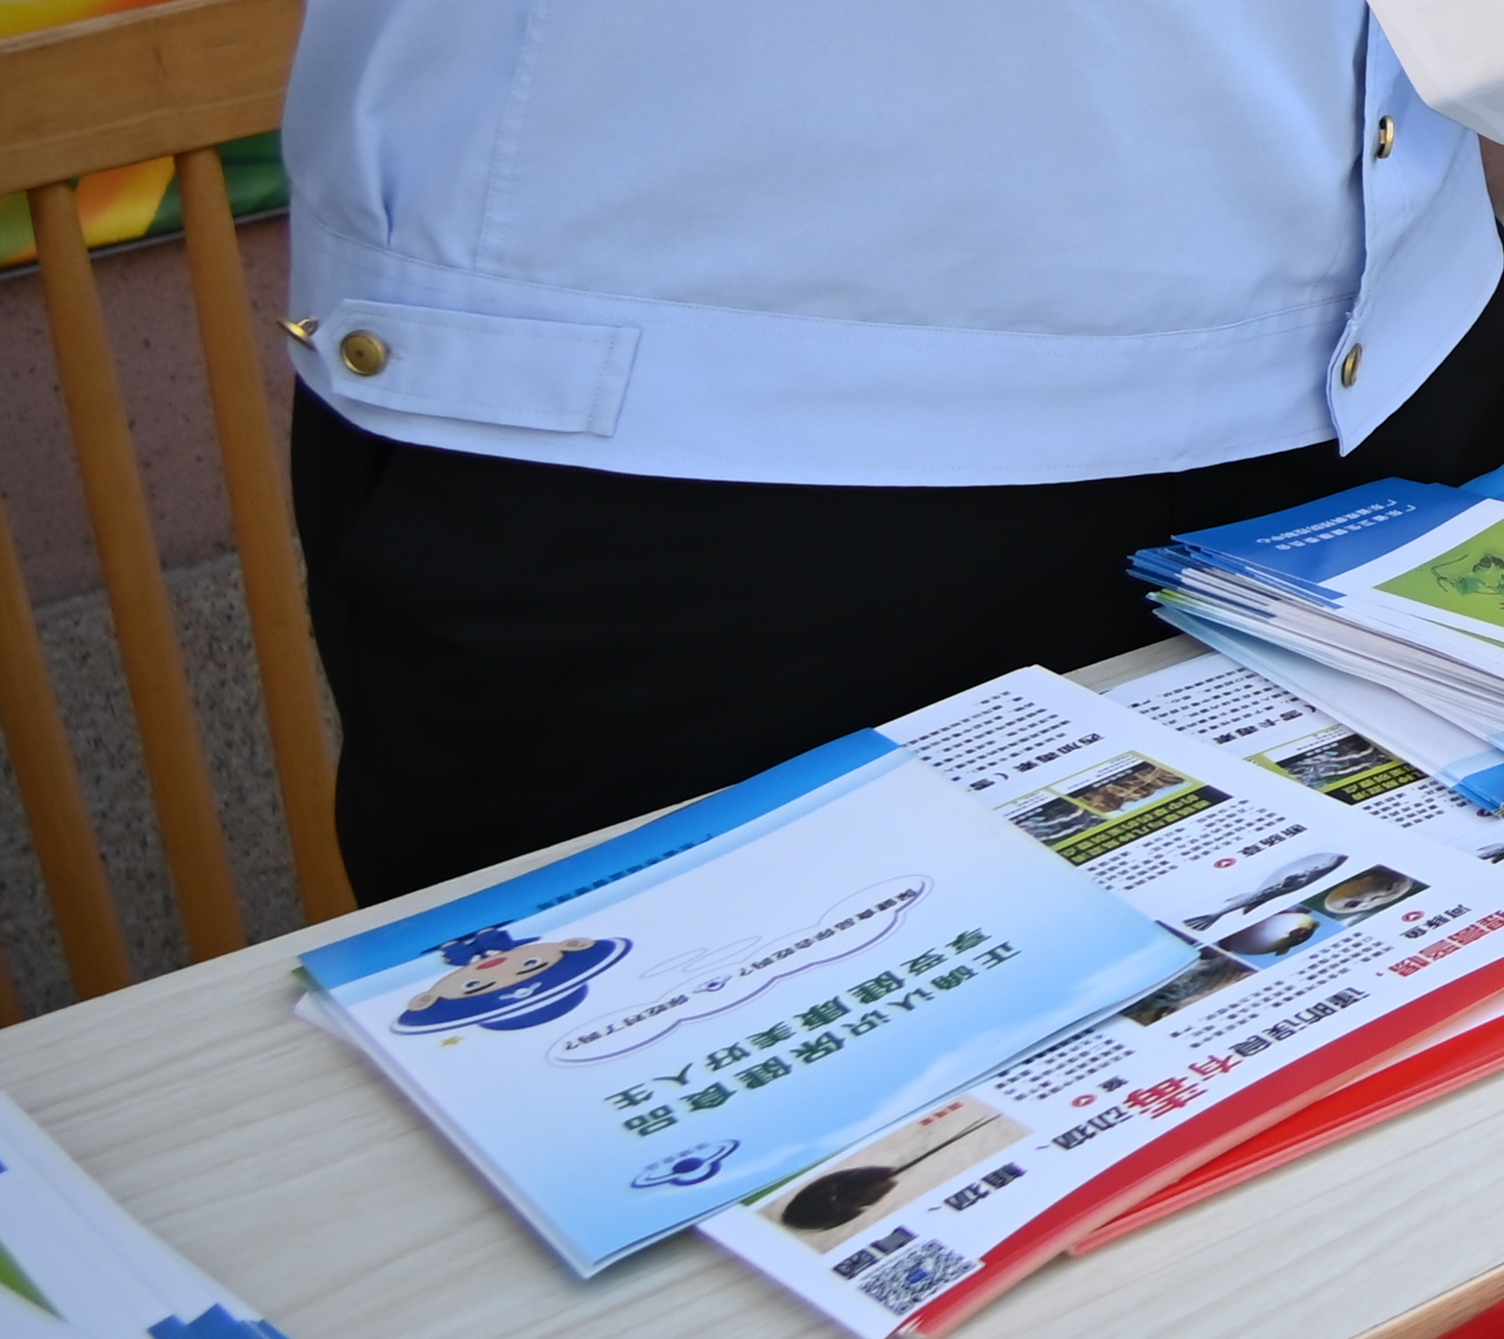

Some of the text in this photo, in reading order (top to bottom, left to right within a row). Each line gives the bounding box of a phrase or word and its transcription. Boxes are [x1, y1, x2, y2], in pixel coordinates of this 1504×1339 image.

[965, 731, 1104, 796] 西加毒素（雪
[603, 923, 993, 1115] 享受健康美好人生
[633, 936, 1023, 1139] 正确认识保健食品
